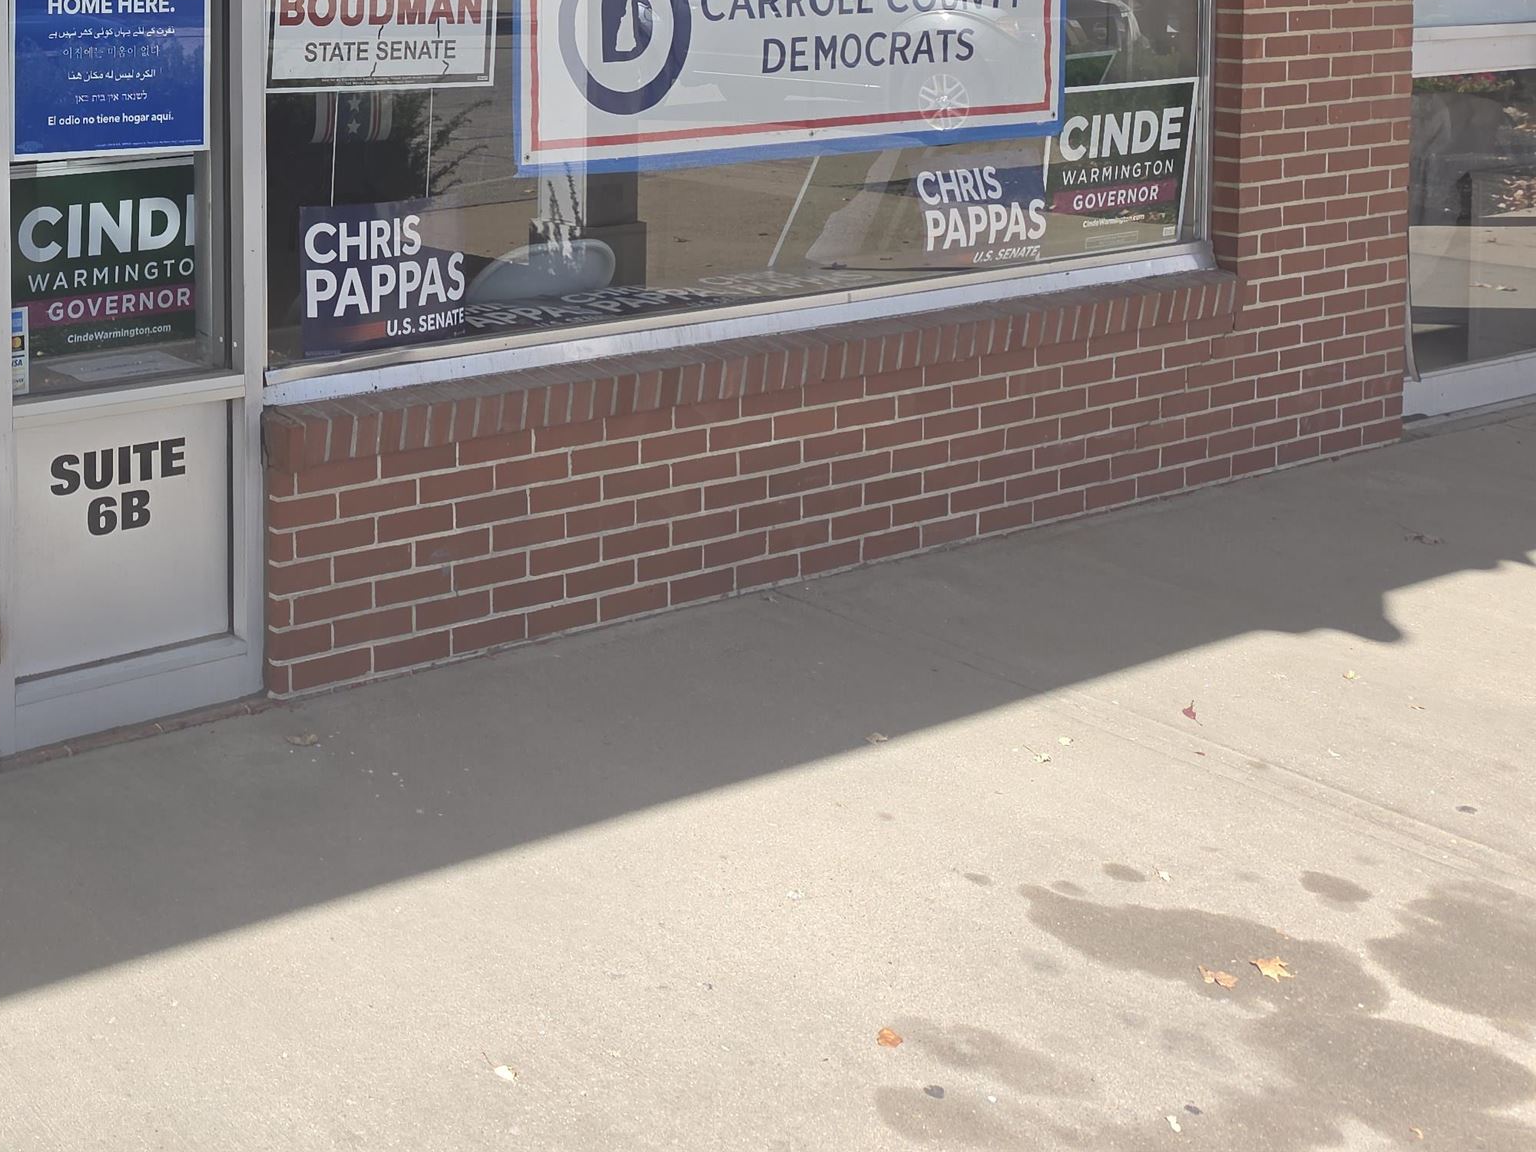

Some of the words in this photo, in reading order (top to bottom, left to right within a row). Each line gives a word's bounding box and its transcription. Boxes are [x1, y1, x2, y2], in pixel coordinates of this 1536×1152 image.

[304, 42, 369, 62] STATE
[376, 40, 456, 61] SENATE
[762, 28, 975, 74] DEMOCRATS
[47, 115, 56, 126] El
[59, 114, 80, 125] odio
[82, 116, 95, 125] no
[96, 113, 120, 124] tiene
[122, 112, 149, 125] hogar
[1059, 107, 1184, 161] CINDE
[917, 166, 1003, 206] CHRIS
[1063, 159, 1174, 185] WARMINGTON
[1073, 185, 1159, 211] GOVERNOR
[304, 215, 422, 264] CHRIS
[925, 199, 1047, 251] PAPPAS
[973, 250, 994, 264] U.S.
[995, 245, 1040, 262] SENATE
[306, 252, 465, 318] PAPPAS
[48, 288, 191, 321] GOVERNOR
[386, 320, 416, 336] U.S.
[419, 308, 465, 332] SENATE
[67, 323, 171, 344] CindeWarmington.com
[50, 437, 186, 496] SUITE
[88, 489, 151, 536] 6B
